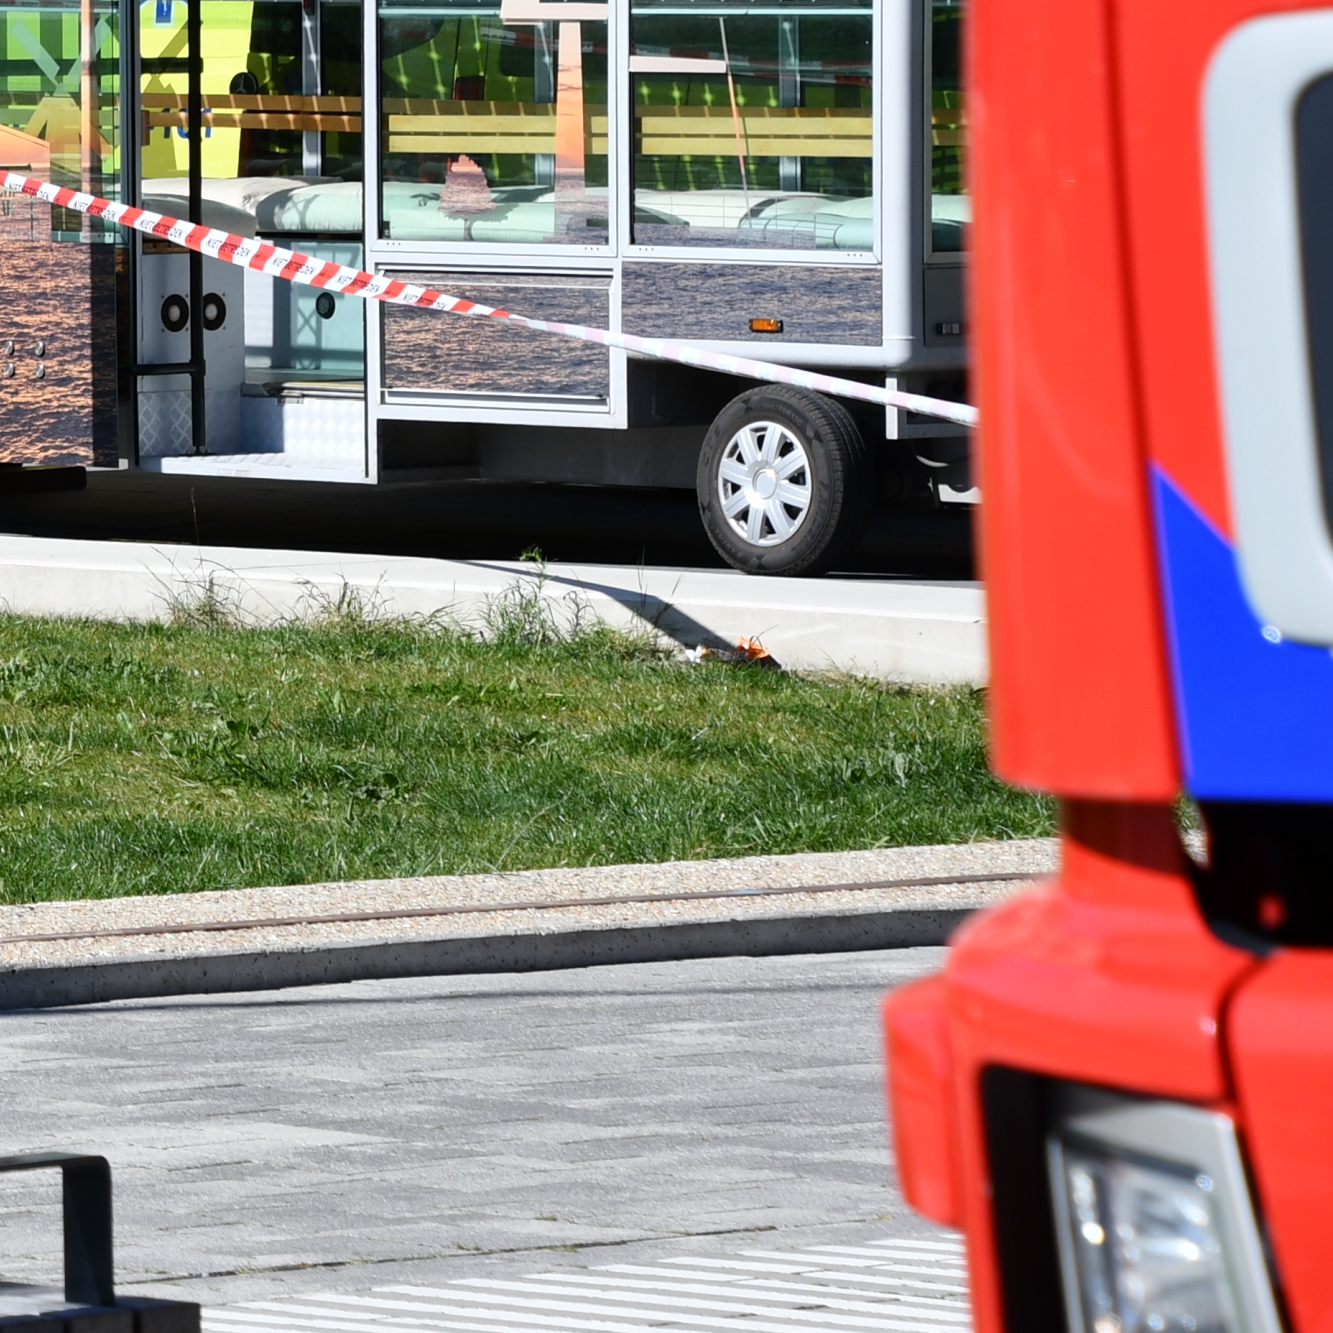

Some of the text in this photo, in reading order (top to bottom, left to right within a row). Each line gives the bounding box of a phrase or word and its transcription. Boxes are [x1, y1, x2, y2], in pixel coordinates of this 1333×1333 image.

[73, 200, 87, 212] NIET
[139, 218, 153, 230] NIET
[207, 236, 221, 250] NIET
[273, 257, 287, 269] NIET
